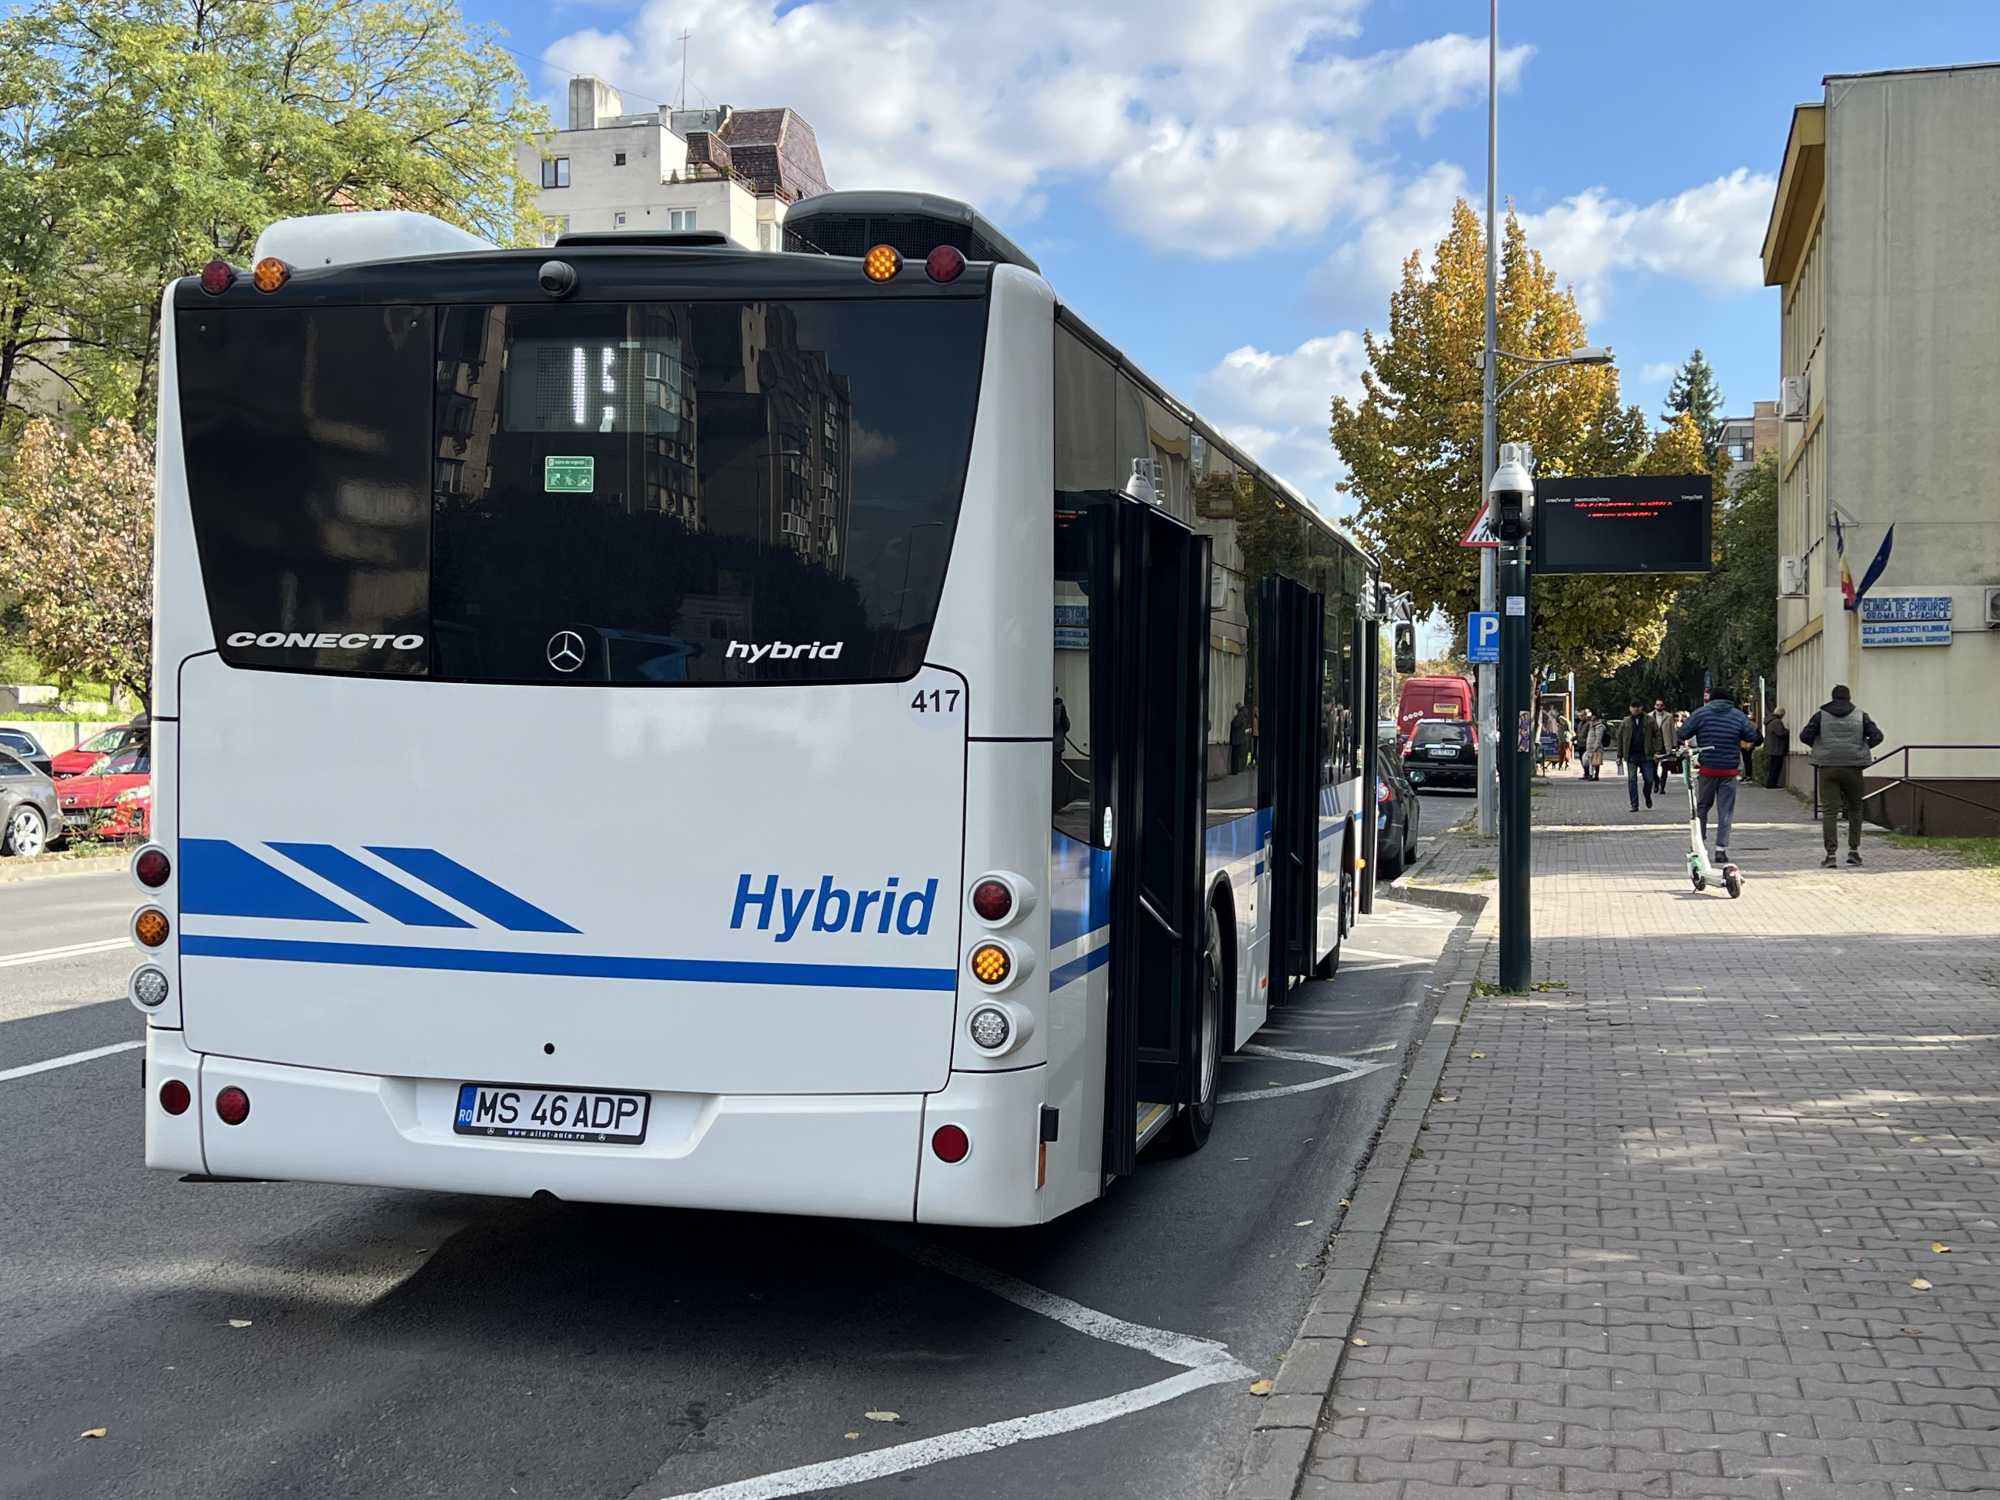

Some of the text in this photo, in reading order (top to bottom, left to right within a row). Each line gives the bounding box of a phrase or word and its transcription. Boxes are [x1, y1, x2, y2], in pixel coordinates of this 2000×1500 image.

[225, 631, 425, 651] CONECTO
[1480, 616, 1499, 646] P
[725, 640, 844, 664] hybrid
[911, 689, 960, 713] 417
[729, 873, 939, 943] Hybrid
[458, 1108, 473, 1123] RO
[475, 1091, 521, 1124] MS
